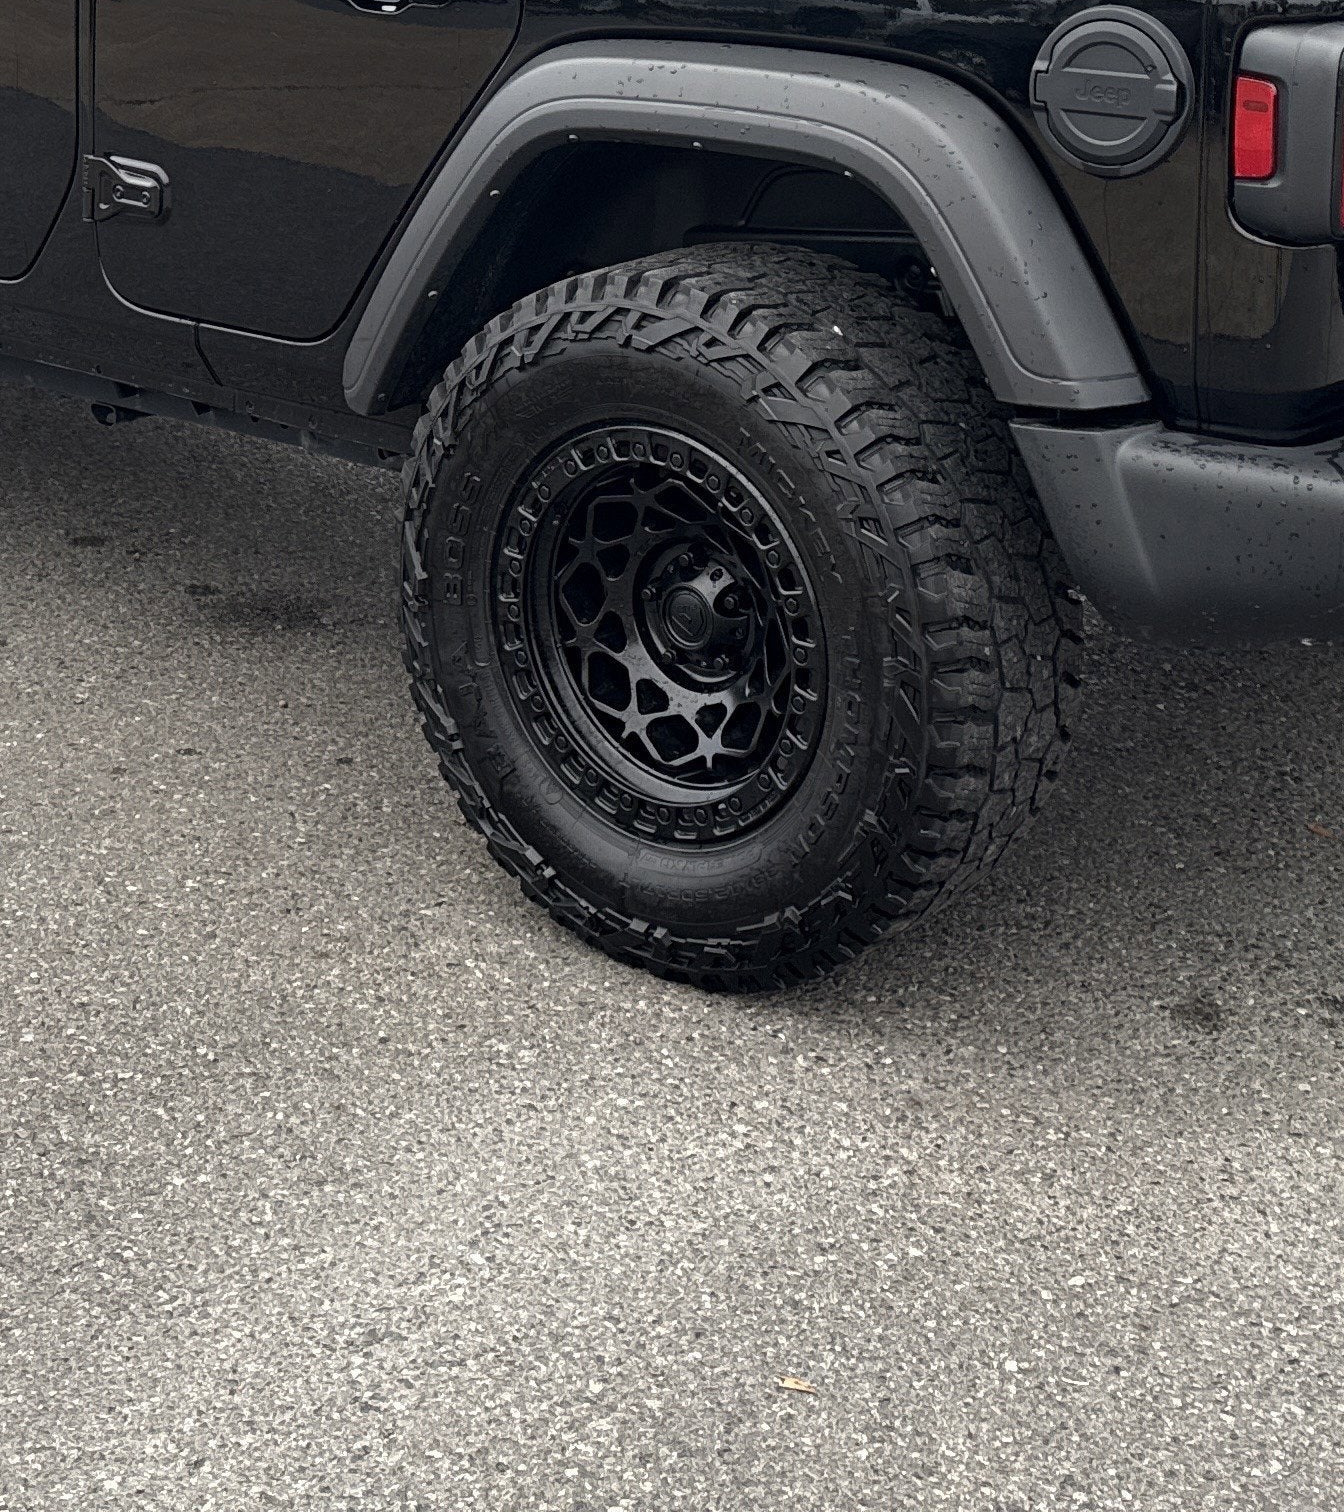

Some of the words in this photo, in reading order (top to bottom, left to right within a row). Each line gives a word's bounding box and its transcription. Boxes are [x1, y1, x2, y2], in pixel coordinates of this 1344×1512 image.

[1075, 78, 1132, 108] Jeep
[443, 472, 484, 606] BOSS
[738, 425, 845, 585] MICKEY
